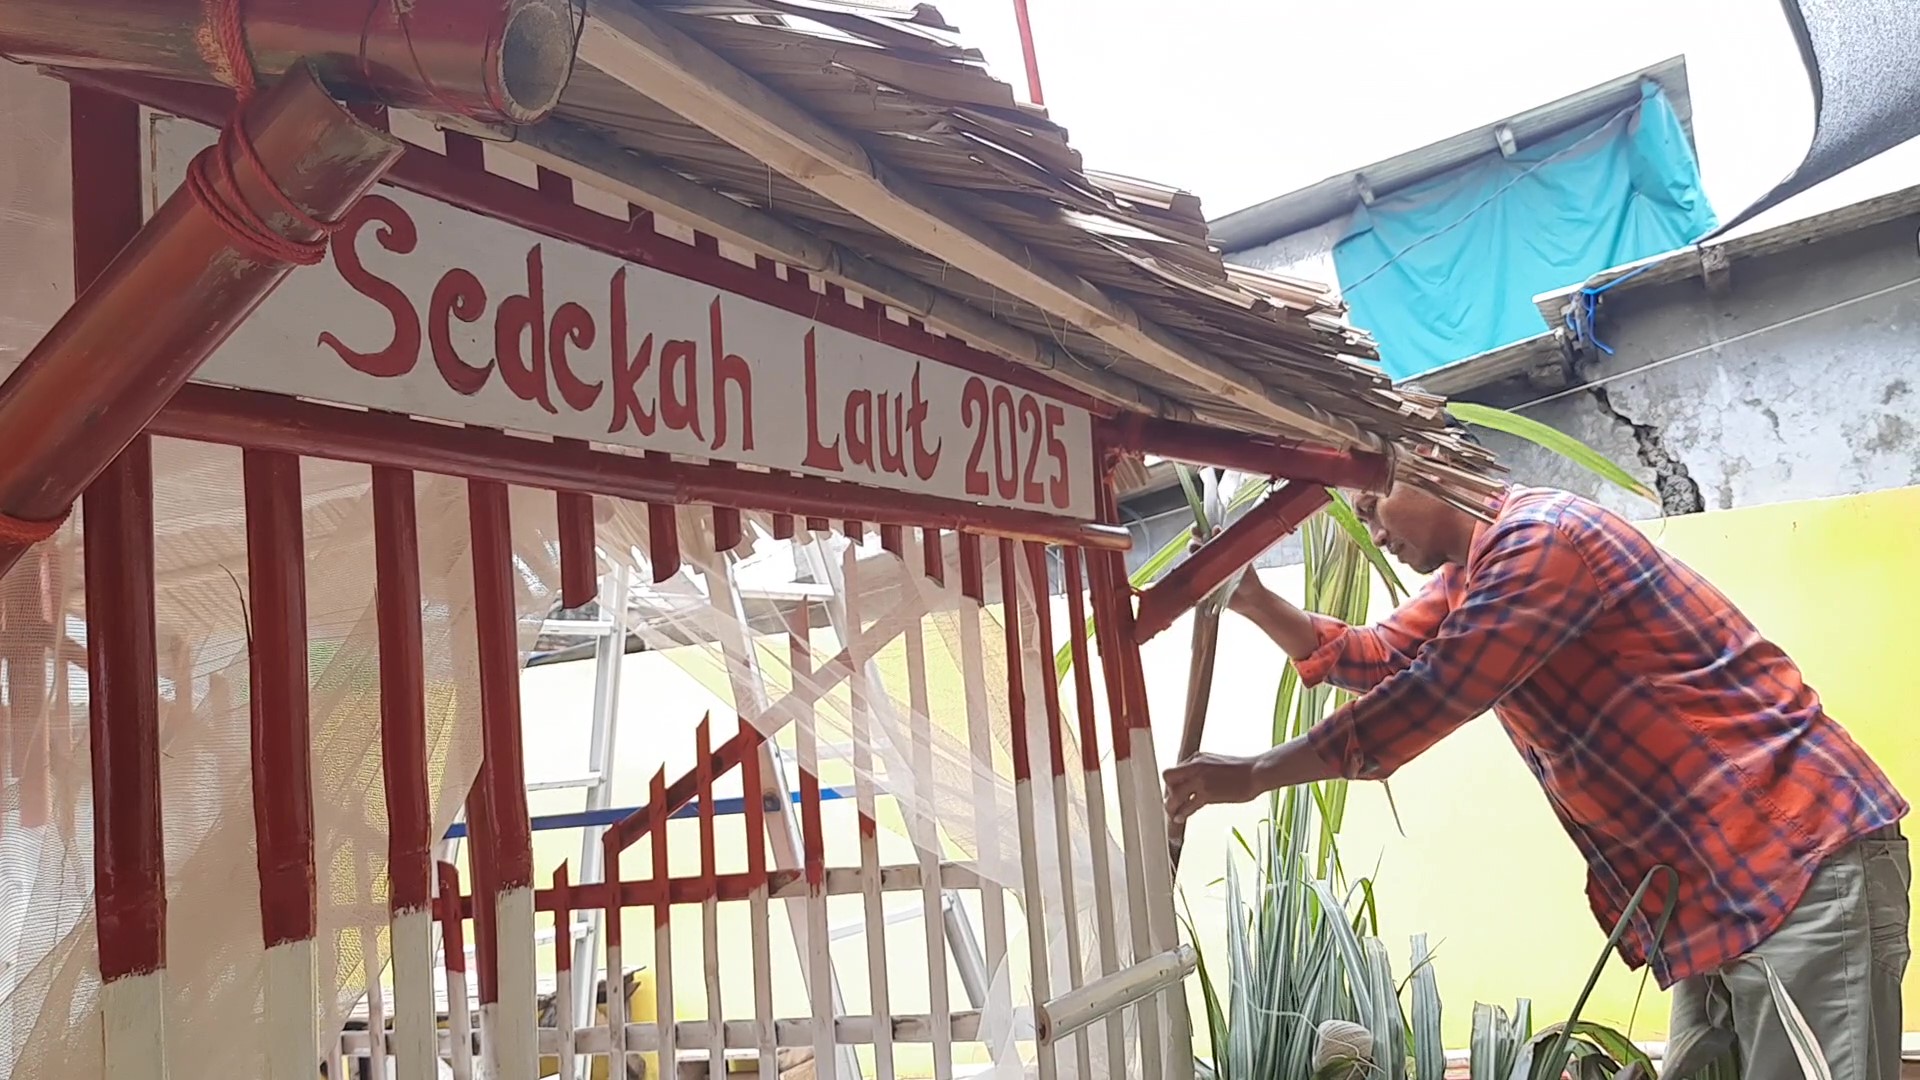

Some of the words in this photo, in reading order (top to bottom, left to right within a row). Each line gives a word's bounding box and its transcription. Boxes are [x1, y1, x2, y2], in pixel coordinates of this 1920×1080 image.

[318, 194, 754, 451] Sedekah
[801, 326, 942, 480] Laut
[961, 376, 1070, 509] 2025
